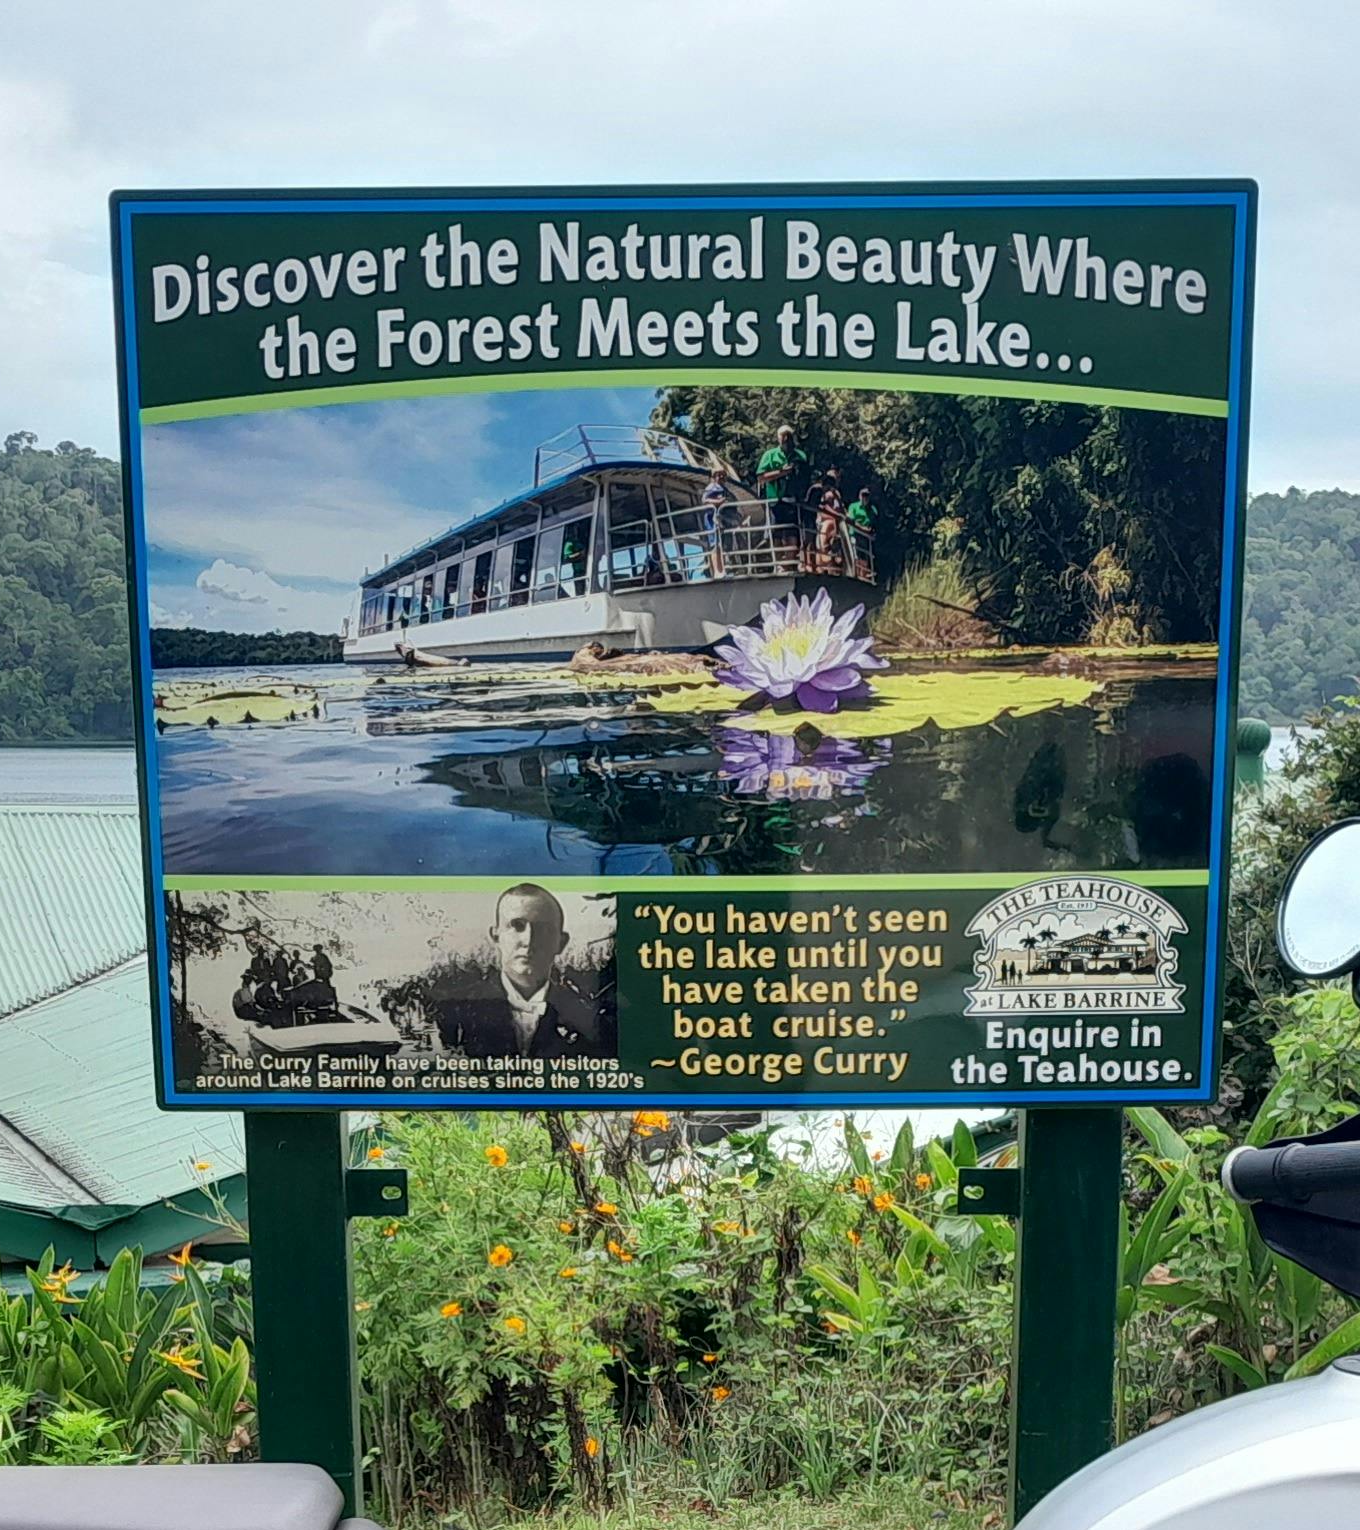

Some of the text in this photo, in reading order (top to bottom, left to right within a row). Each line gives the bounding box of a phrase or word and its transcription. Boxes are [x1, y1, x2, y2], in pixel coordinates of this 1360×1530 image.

[152, 216, 1206, 324] Discover the Natural Beauty Where
[260, 295, 1093, 378] the Forest Meets the Lake...
[987, 882, 1166, 925] THE TEAHOUSE
[869, 911, 946, 931] seen
[639, 938, 941, 973] the lake until you
[663, 970, 918, 1003] have taken the
[997, 993, 1057, 1010] LAKE
[1062, 990, 1167, 1009] BARRINE
[675, 1009, 752, 1038] boat
[986, 1018, 1161, 1055] Enquire in
[197, 1072, 261, 1087] around
[268, 1072, 311, 1087] Lake
[318, 1072, 385, 1087] Barrine
[392, 1076, 415, 1088] on
[422, 1073, 489, 1088] cruises
[496, 1073, 544, 1088] since
[551, 1073, 579, 1088] the
[219, 1054, 619, 1074] The Curry Family have been taking visitors
[815, 1047, 907, 1080] Curry
[951, 1053, 1191, 1083] the Teahouse.
